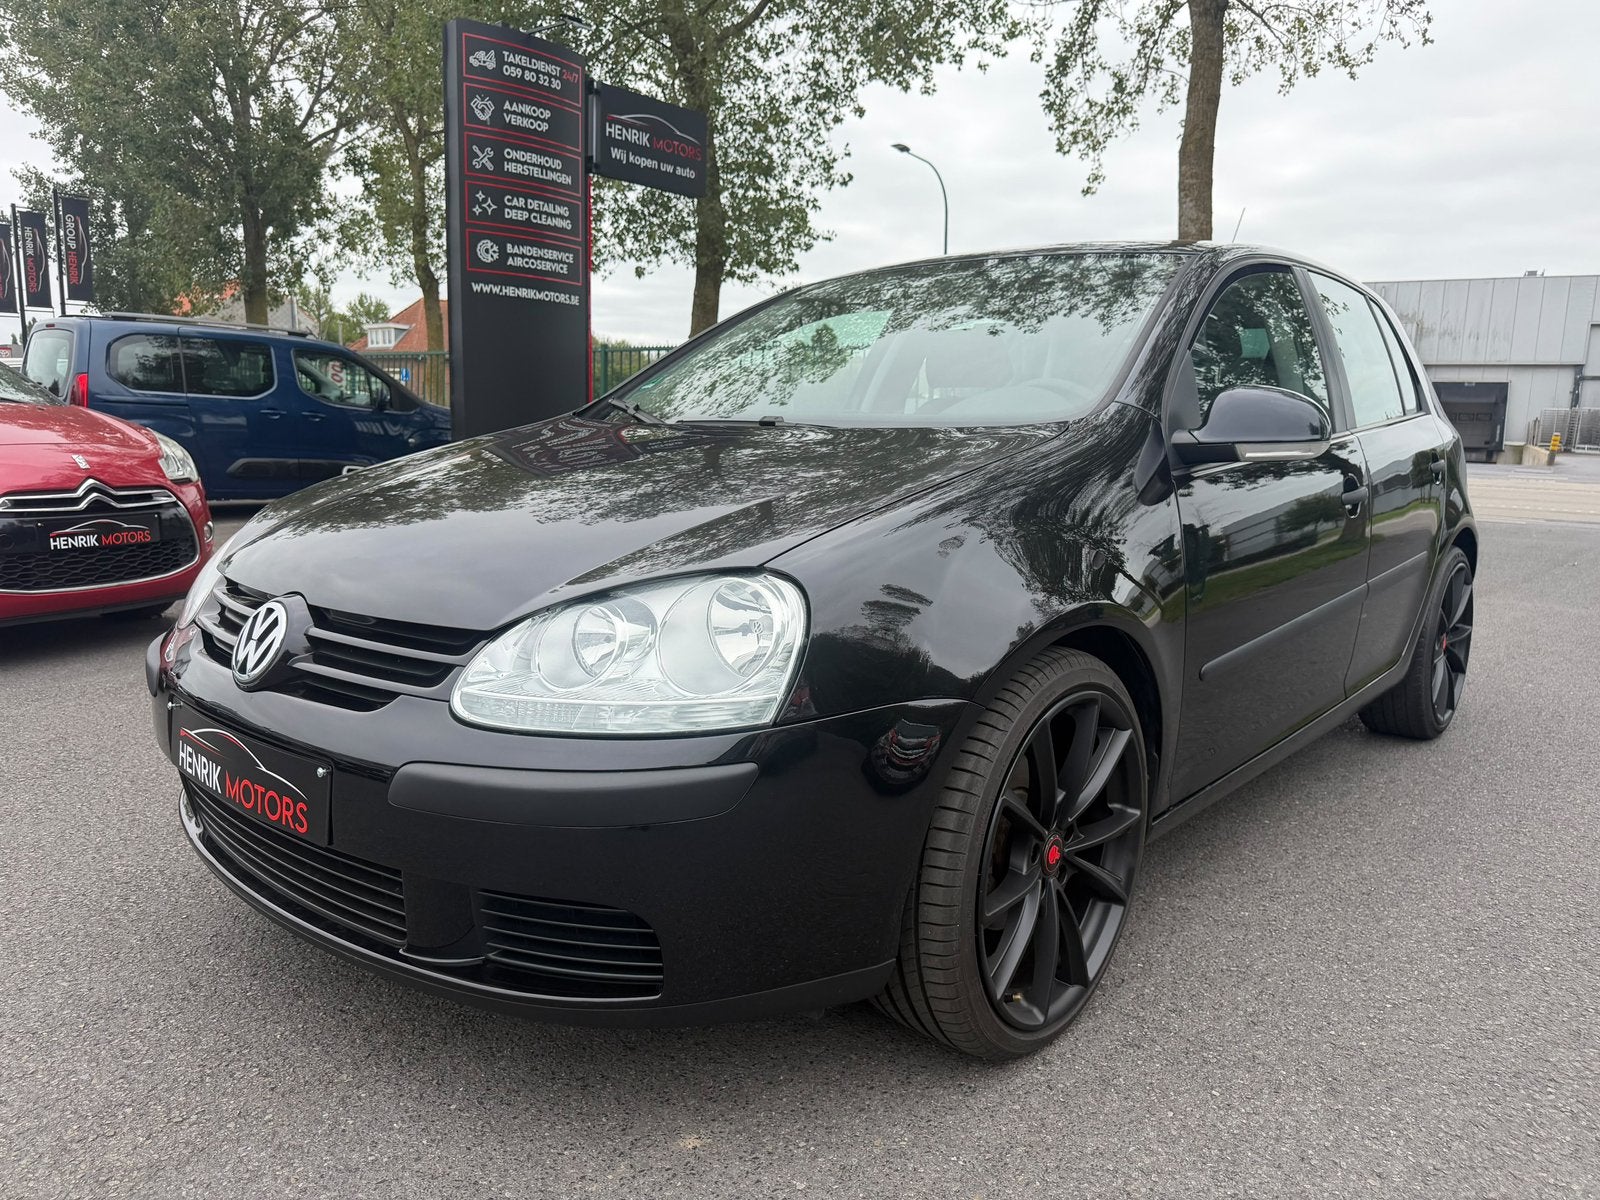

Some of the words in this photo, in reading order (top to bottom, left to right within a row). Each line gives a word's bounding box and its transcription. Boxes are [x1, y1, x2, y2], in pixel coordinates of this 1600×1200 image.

[502, 50, 561, 77] TAKELDIENST
[562, 69, 579, 83] 24/7
[503, 65, 523, 78] 059
[524, 71, 537, 83] 80
[538, 75, 550, 87] 32
[551, 79, 562, 90] 30
[503, 100, 552, 119] AANKOOP
[503, 113, 549, 132] VERKOOP
[605, 122, 650, 148] HENRIK
[652, 136, 702, 161] MOTORS
[503, 148, 562, 170] ONDERHOUD
[610, 147, 627, 164] Wij
[629, 151, 658, 169] kopen
[660, 163, 674, 173] uw
[675, 166, 696, 179] auto
[504, 161, 572, 185] HERSTELLINGEN
[504, 195, 526, 209] CAR
[527, 198, 569, 217] DETAILING
[504, 208, 529, 221] DEEP
[530, 212, 572, 230] CLEANING
[24, 226, 34, 256] HENRIK
[65, 214, 76, 250] GROUP
[506, 243, 574, 264] BANDENSERVICE
[507, 256, 568, 274] AIRCOSERVICE
[27, 257, 37, 293] MOTORS
[68, 251, 80, 285] HENRIK
[471, 282, 580, 306] WWW.HENRIKMOTORS.BE
[50, 534, 99, 550] HENRIK
[101, 530, 151, 546] MOTORS
[179, 740, 222, 794] HENRIK
[225, 770, 309, 834] MOTORS
